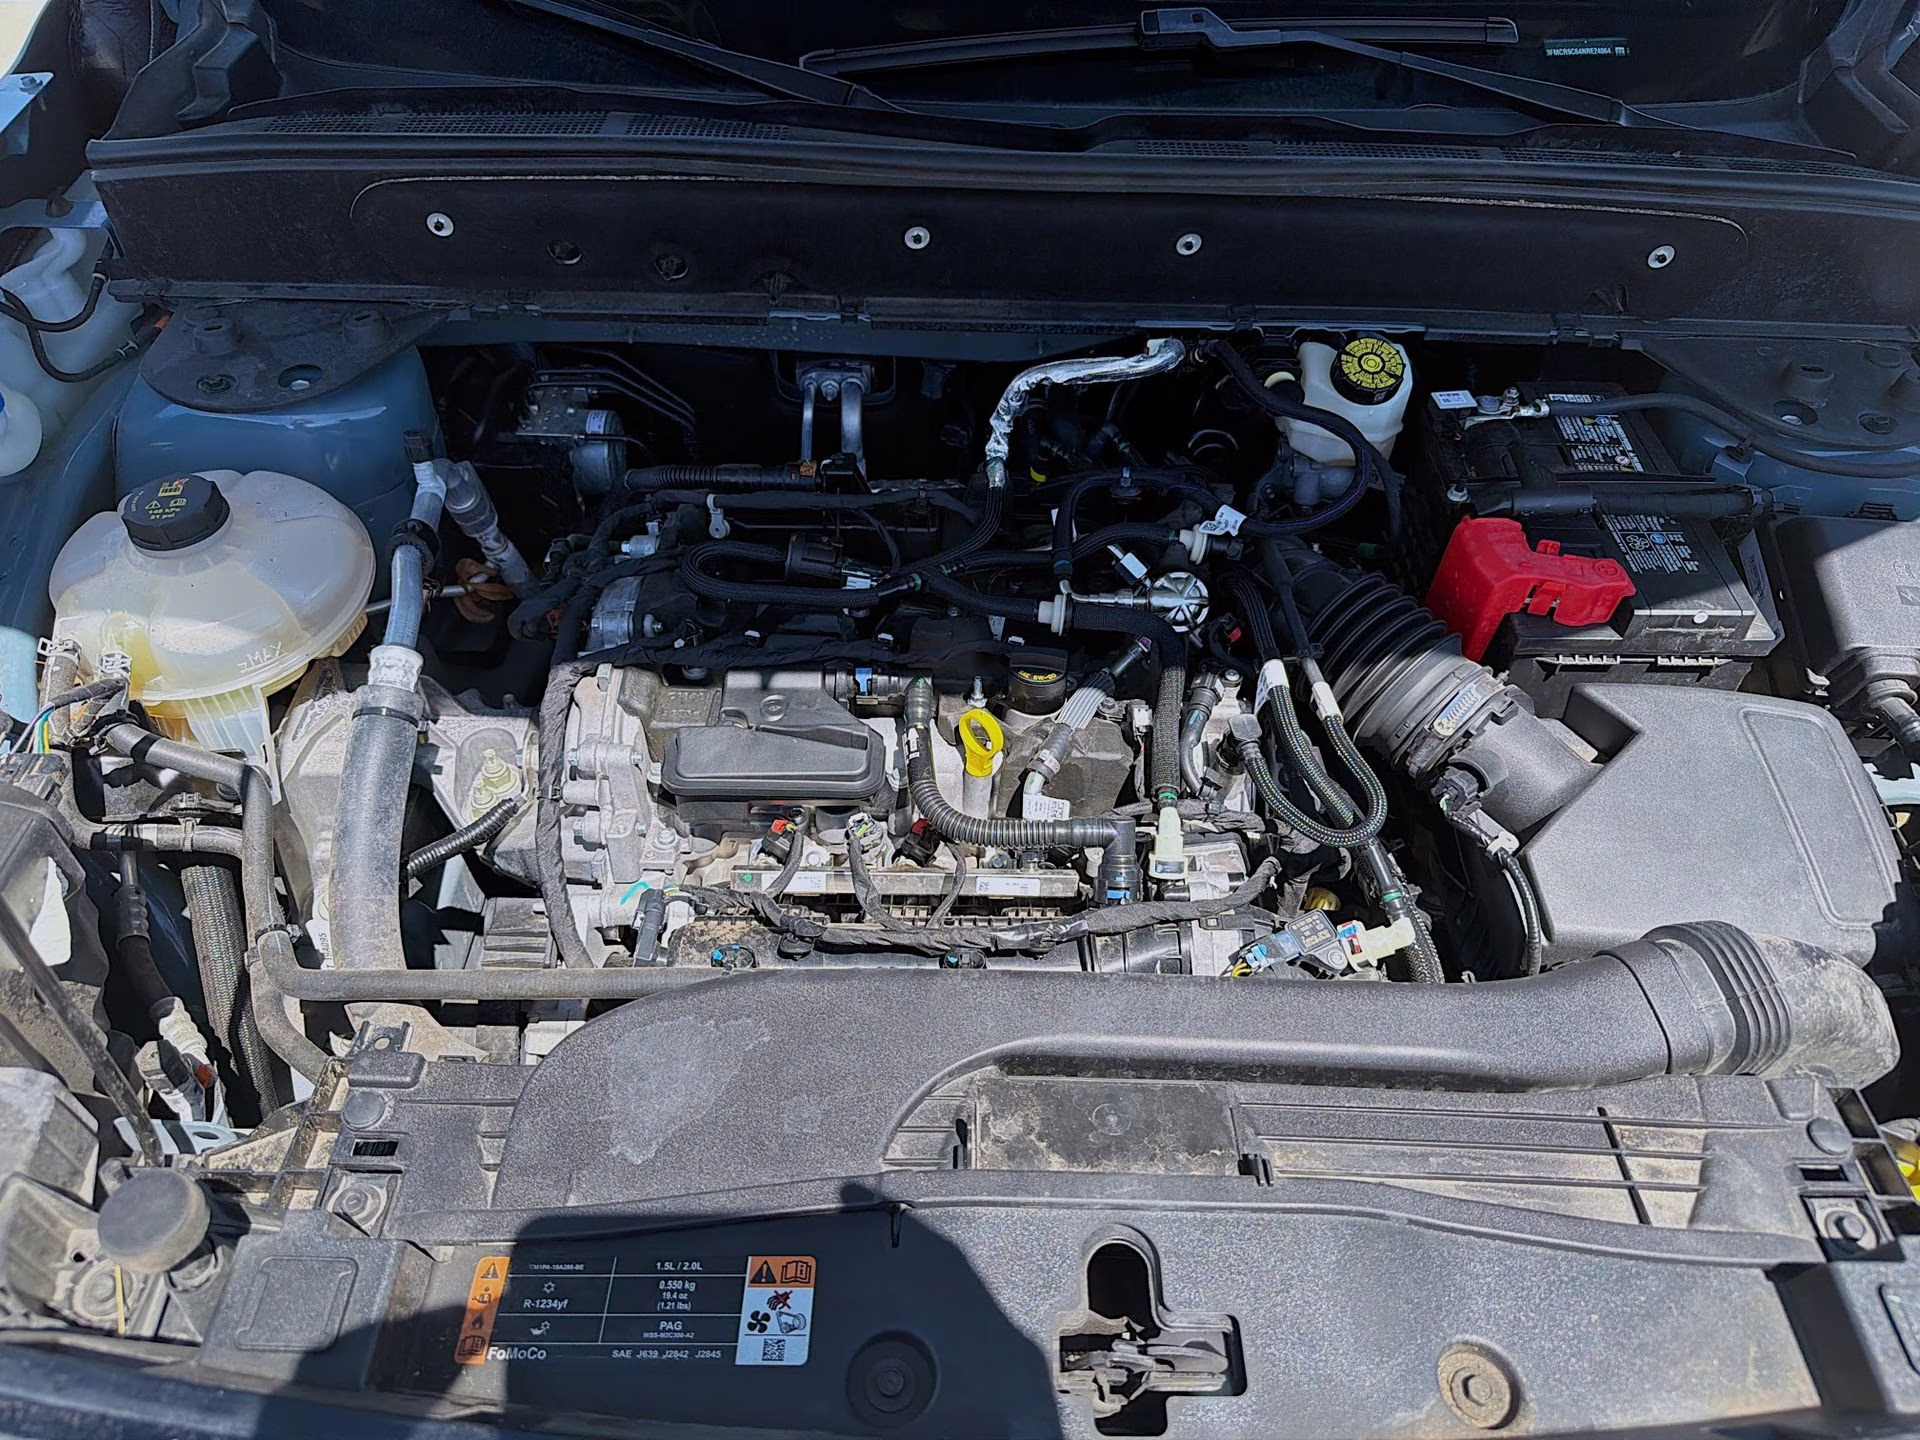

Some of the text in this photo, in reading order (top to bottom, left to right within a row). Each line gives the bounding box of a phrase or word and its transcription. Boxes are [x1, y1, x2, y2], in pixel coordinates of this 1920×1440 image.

[246, 641, 288, 667] MAX
[655, 1261, 676, 1271] 1.5L
[682, 1261, 703, 1271] 2.0L
[658, 1280, 696, 1292] 0.550 kg
[661, 1291, 689, 1300] 19.4 oz
[523, 1298, 569, 1311] R-1234yf
[657, 1301, 692, 1311] (1.21 lbs)
[659, 1321, 683, 1331] PAG
[486, 1346, 548, 1361] FoMoCo
[611, 1349, 722, 1359] SAE J639 J2842 J2845
